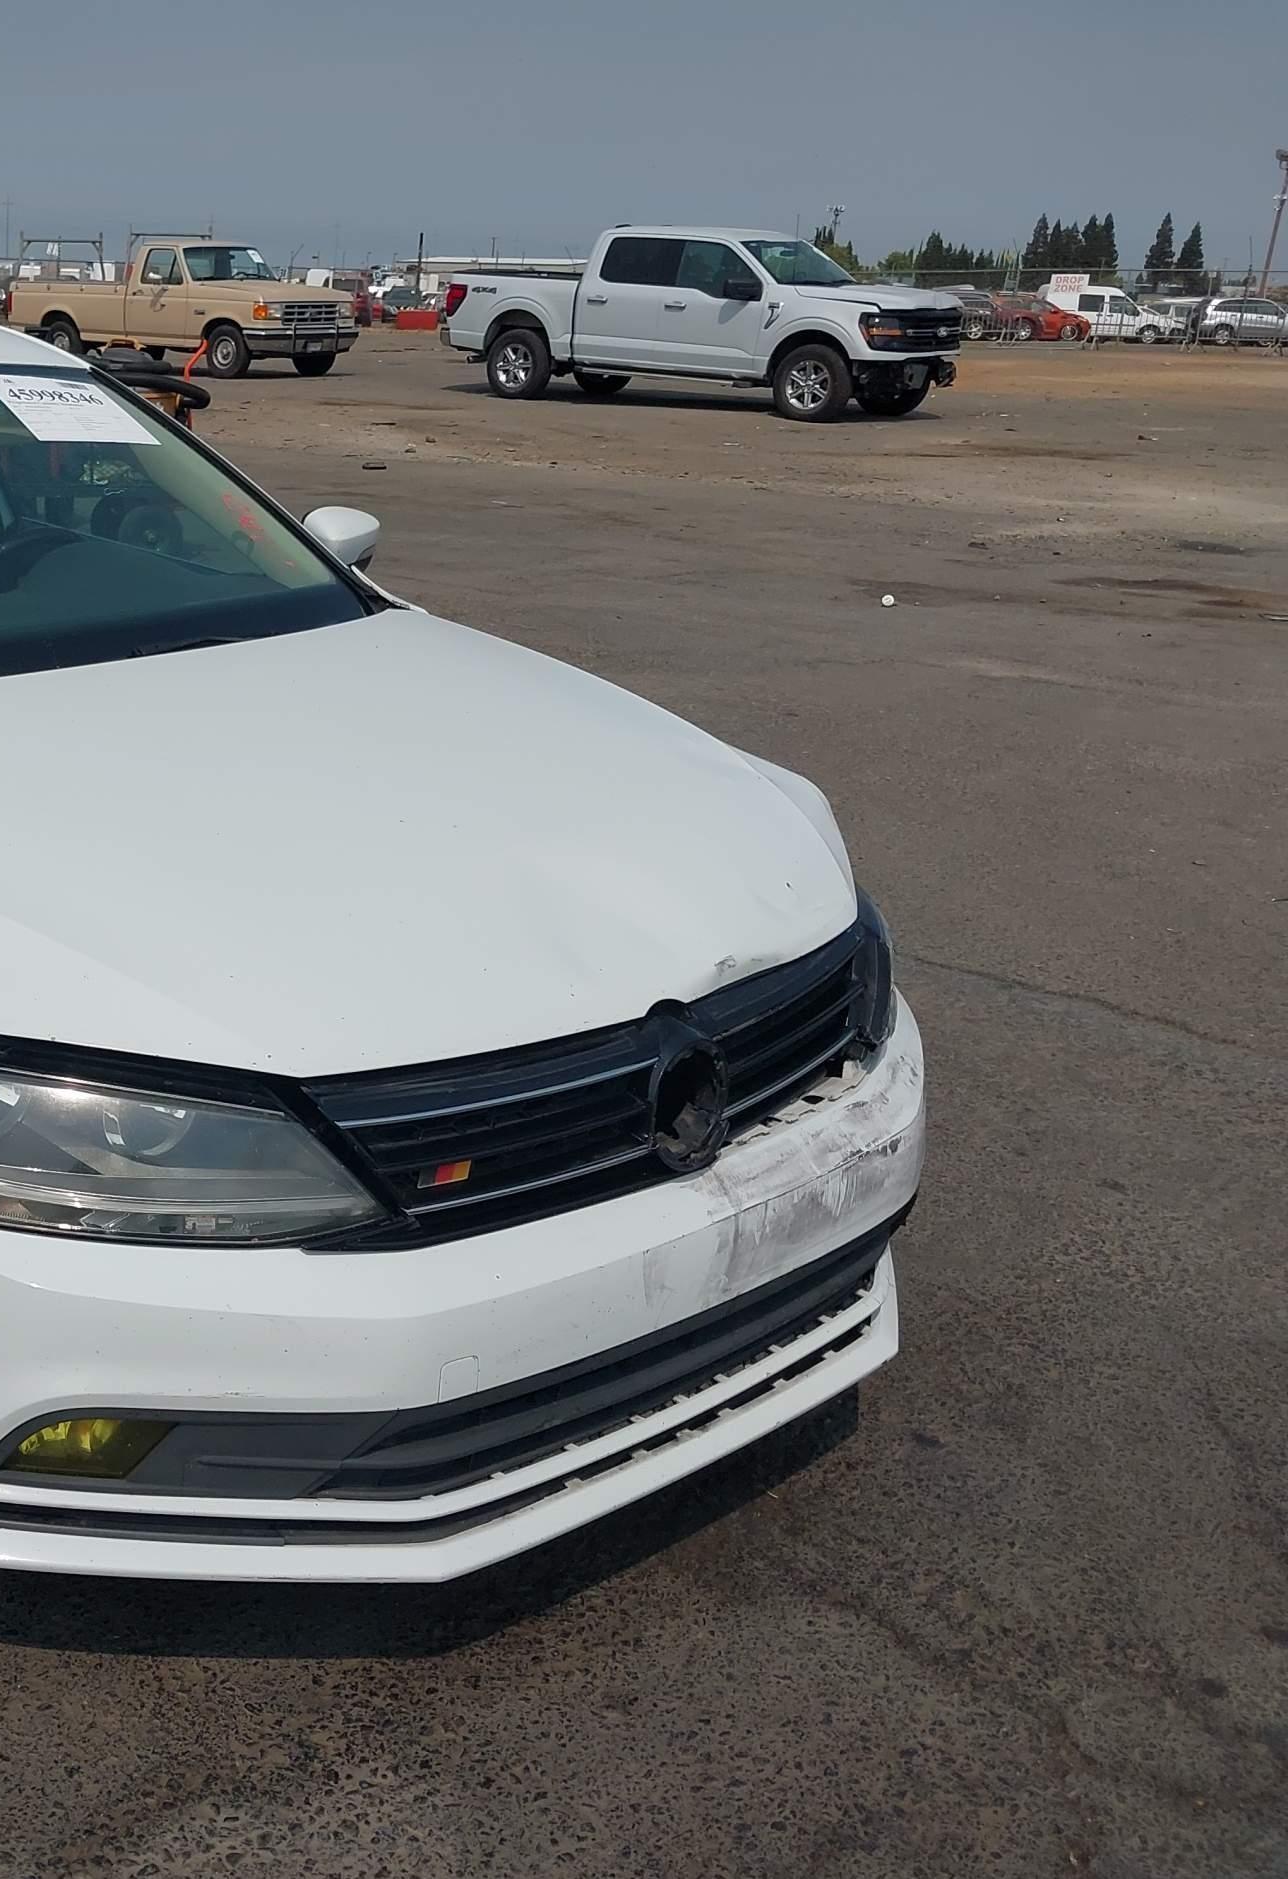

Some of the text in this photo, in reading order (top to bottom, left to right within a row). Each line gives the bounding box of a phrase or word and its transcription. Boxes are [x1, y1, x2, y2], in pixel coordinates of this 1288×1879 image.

[1055, 275, 1085, 284] DROP
[1054, 284, 1083, 293] ZONE
[7, 387, 105, 406] 45998346
